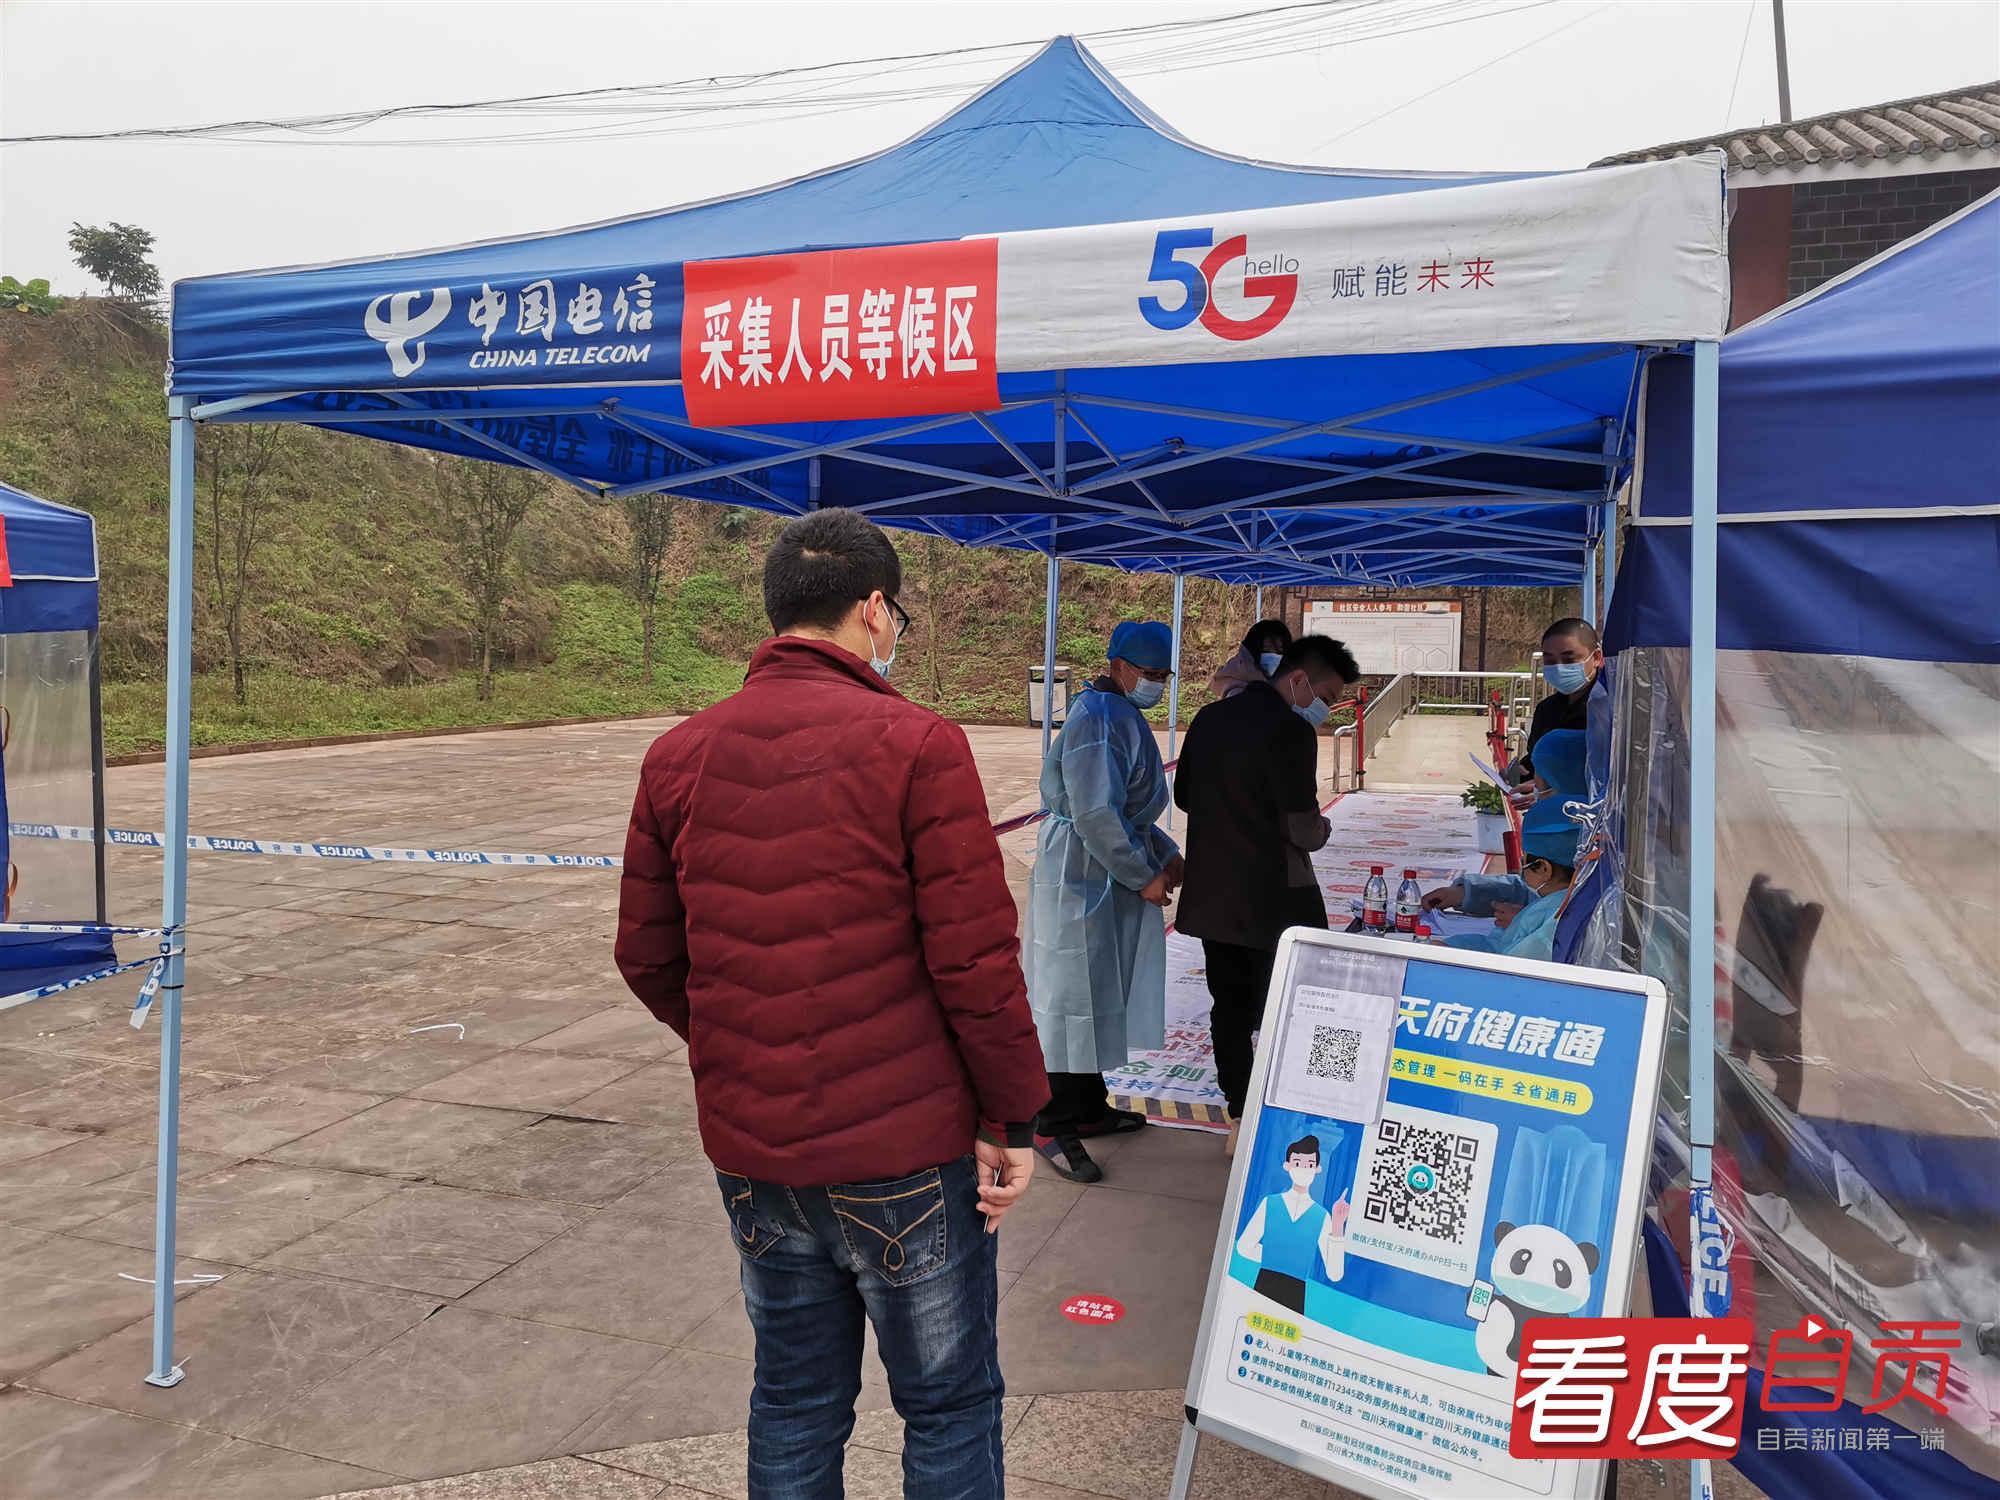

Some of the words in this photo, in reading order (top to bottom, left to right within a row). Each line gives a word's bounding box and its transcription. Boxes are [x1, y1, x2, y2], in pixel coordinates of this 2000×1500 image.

[1138, 227, 1298, 341] 5G
[1244, 253, 1300, 276] hello
[1332, 257, 1495, 299] 赋能未来
[468, 271, 657, 348] 中国电信
[469, 350, 539, 369] CHINA
[545, 343, 651, 367] TELECOM
[700, 285, 979, 390] 采集人员等候区
[1395, 994, 1606, 1067] 天府健康通
[1443, 1069, 1504, 1091] 一码在手
[1512, 1081, 1577, 1106] 全省通用
[1252, 1315, 1296, 1337] 特别提醒
